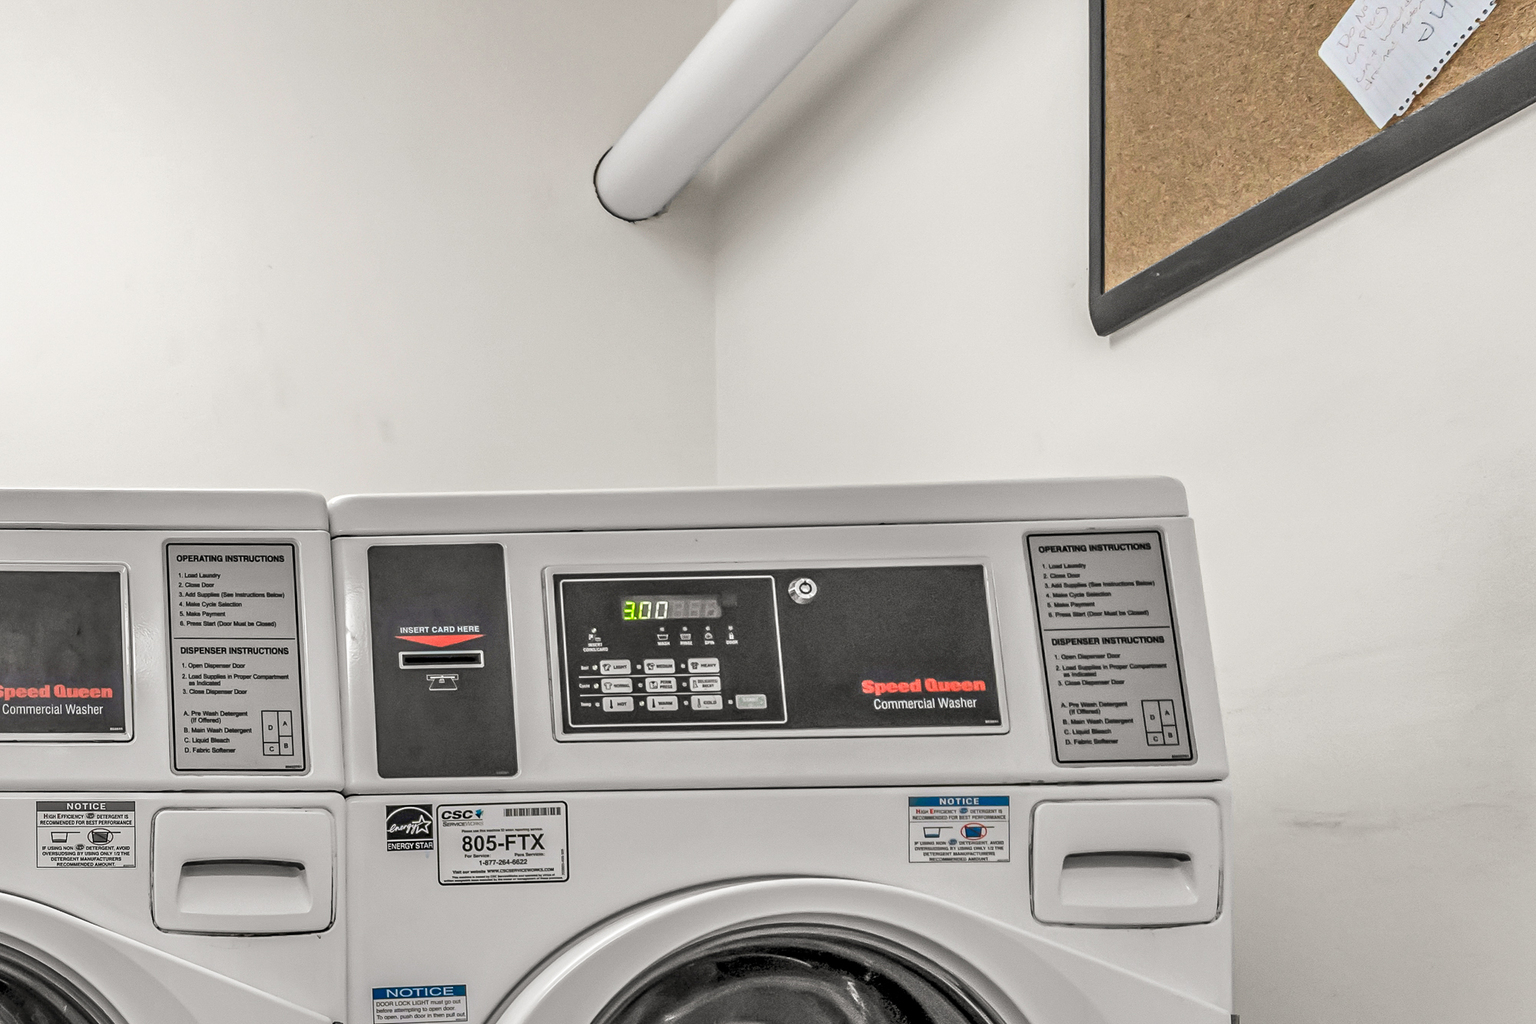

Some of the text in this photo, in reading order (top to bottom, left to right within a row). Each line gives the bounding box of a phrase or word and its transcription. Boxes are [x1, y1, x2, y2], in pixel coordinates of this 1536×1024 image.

[1038, 543, 1151, 553] OPERATING INSTRUCTIONS
[176, 555, 284, 563] OPERATING INSTRUCTIONS
[623, 601, 668, 620] 3.00
[1052, 636, 1165, 646] DISPENSER INSTRUCTIONS
[54, 684, 112, 698] Queen
[862, 678, 986, 696] Speed Queen
[874, 697, 977, 710] Commercial Washer
[2, 704, 103, 715] Commercial Washer
[442, 810, 473, 819] CSC
[388, 842, 413, 850] ENERGY
[462, 834, 545, 851] 805-FTX
[386, 987, 454, 997] NOTICE
